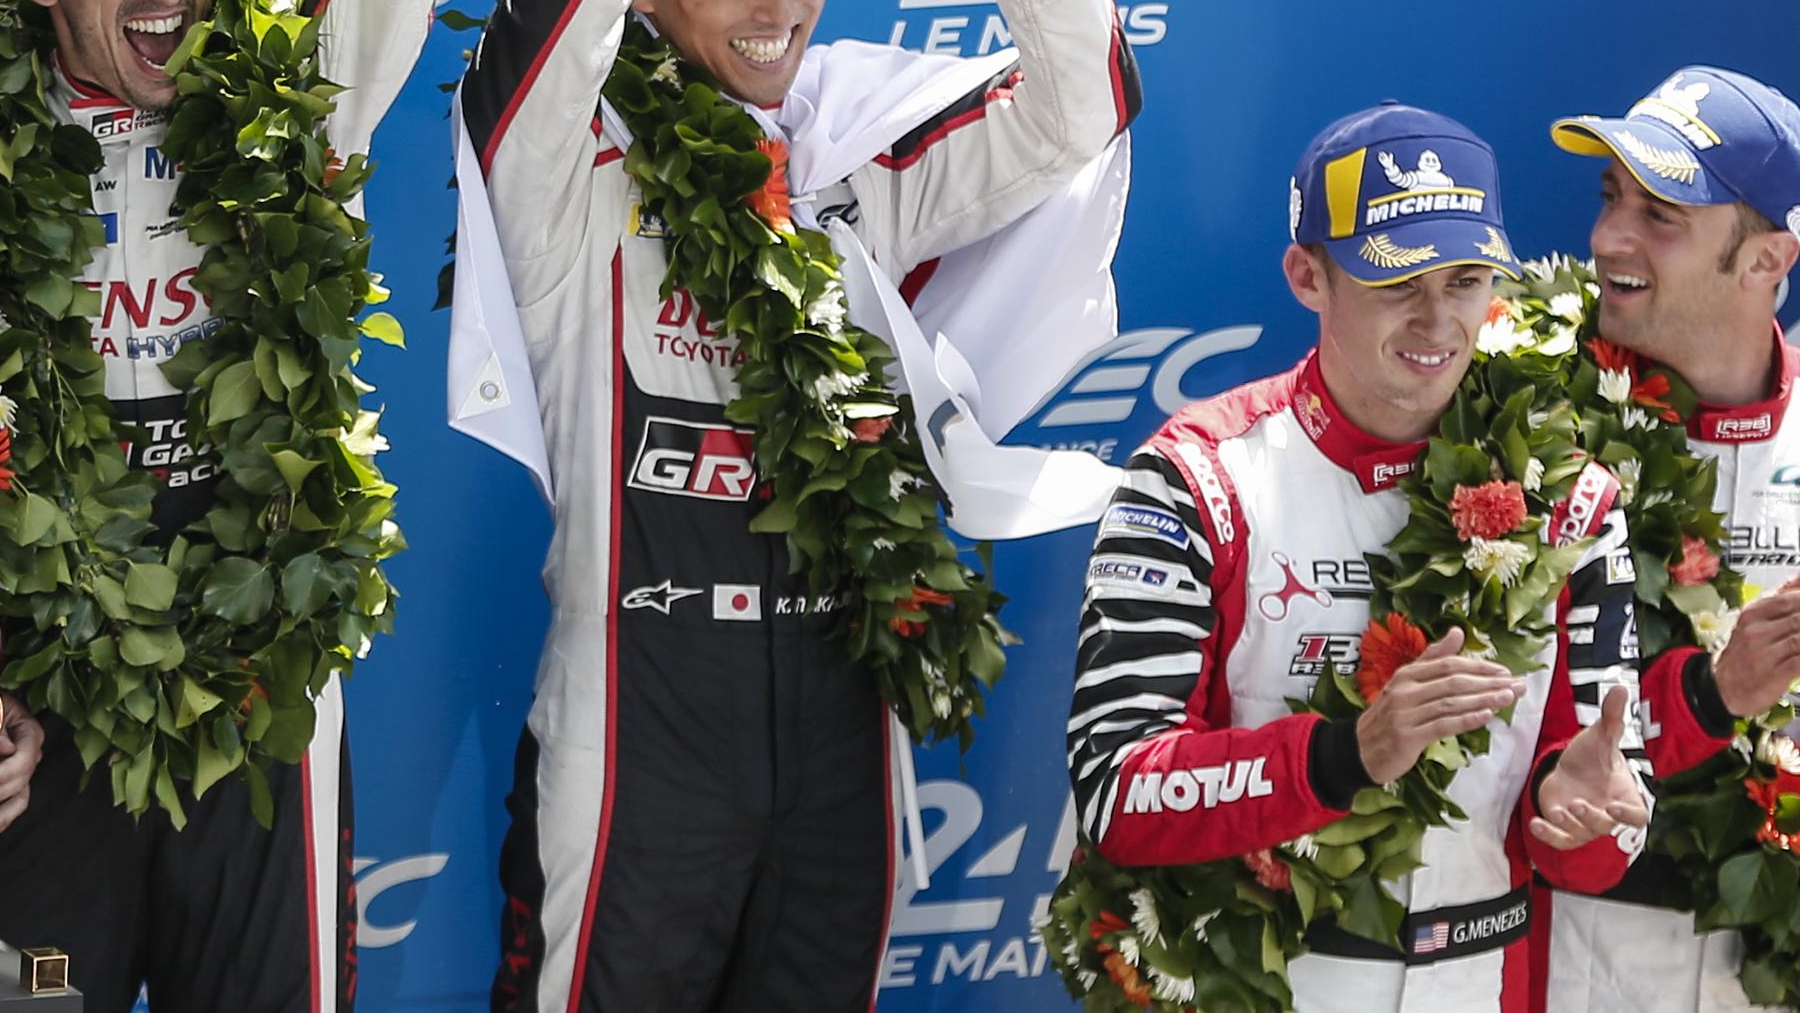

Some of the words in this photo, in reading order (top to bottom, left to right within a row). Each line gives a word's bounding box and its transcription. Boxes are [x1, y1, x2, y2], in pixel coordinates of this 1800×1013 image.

[889, 15, 970, 56] LE
[93, 117, 132, 138] GR
[94, 179, 117, 192] AW
[1365, 193, 1484, 226] MICHELIN
[654, 333, 749, 367] TOYOTA
[636, 448, 756, 496] GR
[1109, 510, 1180, 534] MICHELIN
[1123, 756, 1274, 815] MOTUL
[1453, 902, 1527, 945] G.MENEZES
[879, 946, 923, 989] E
